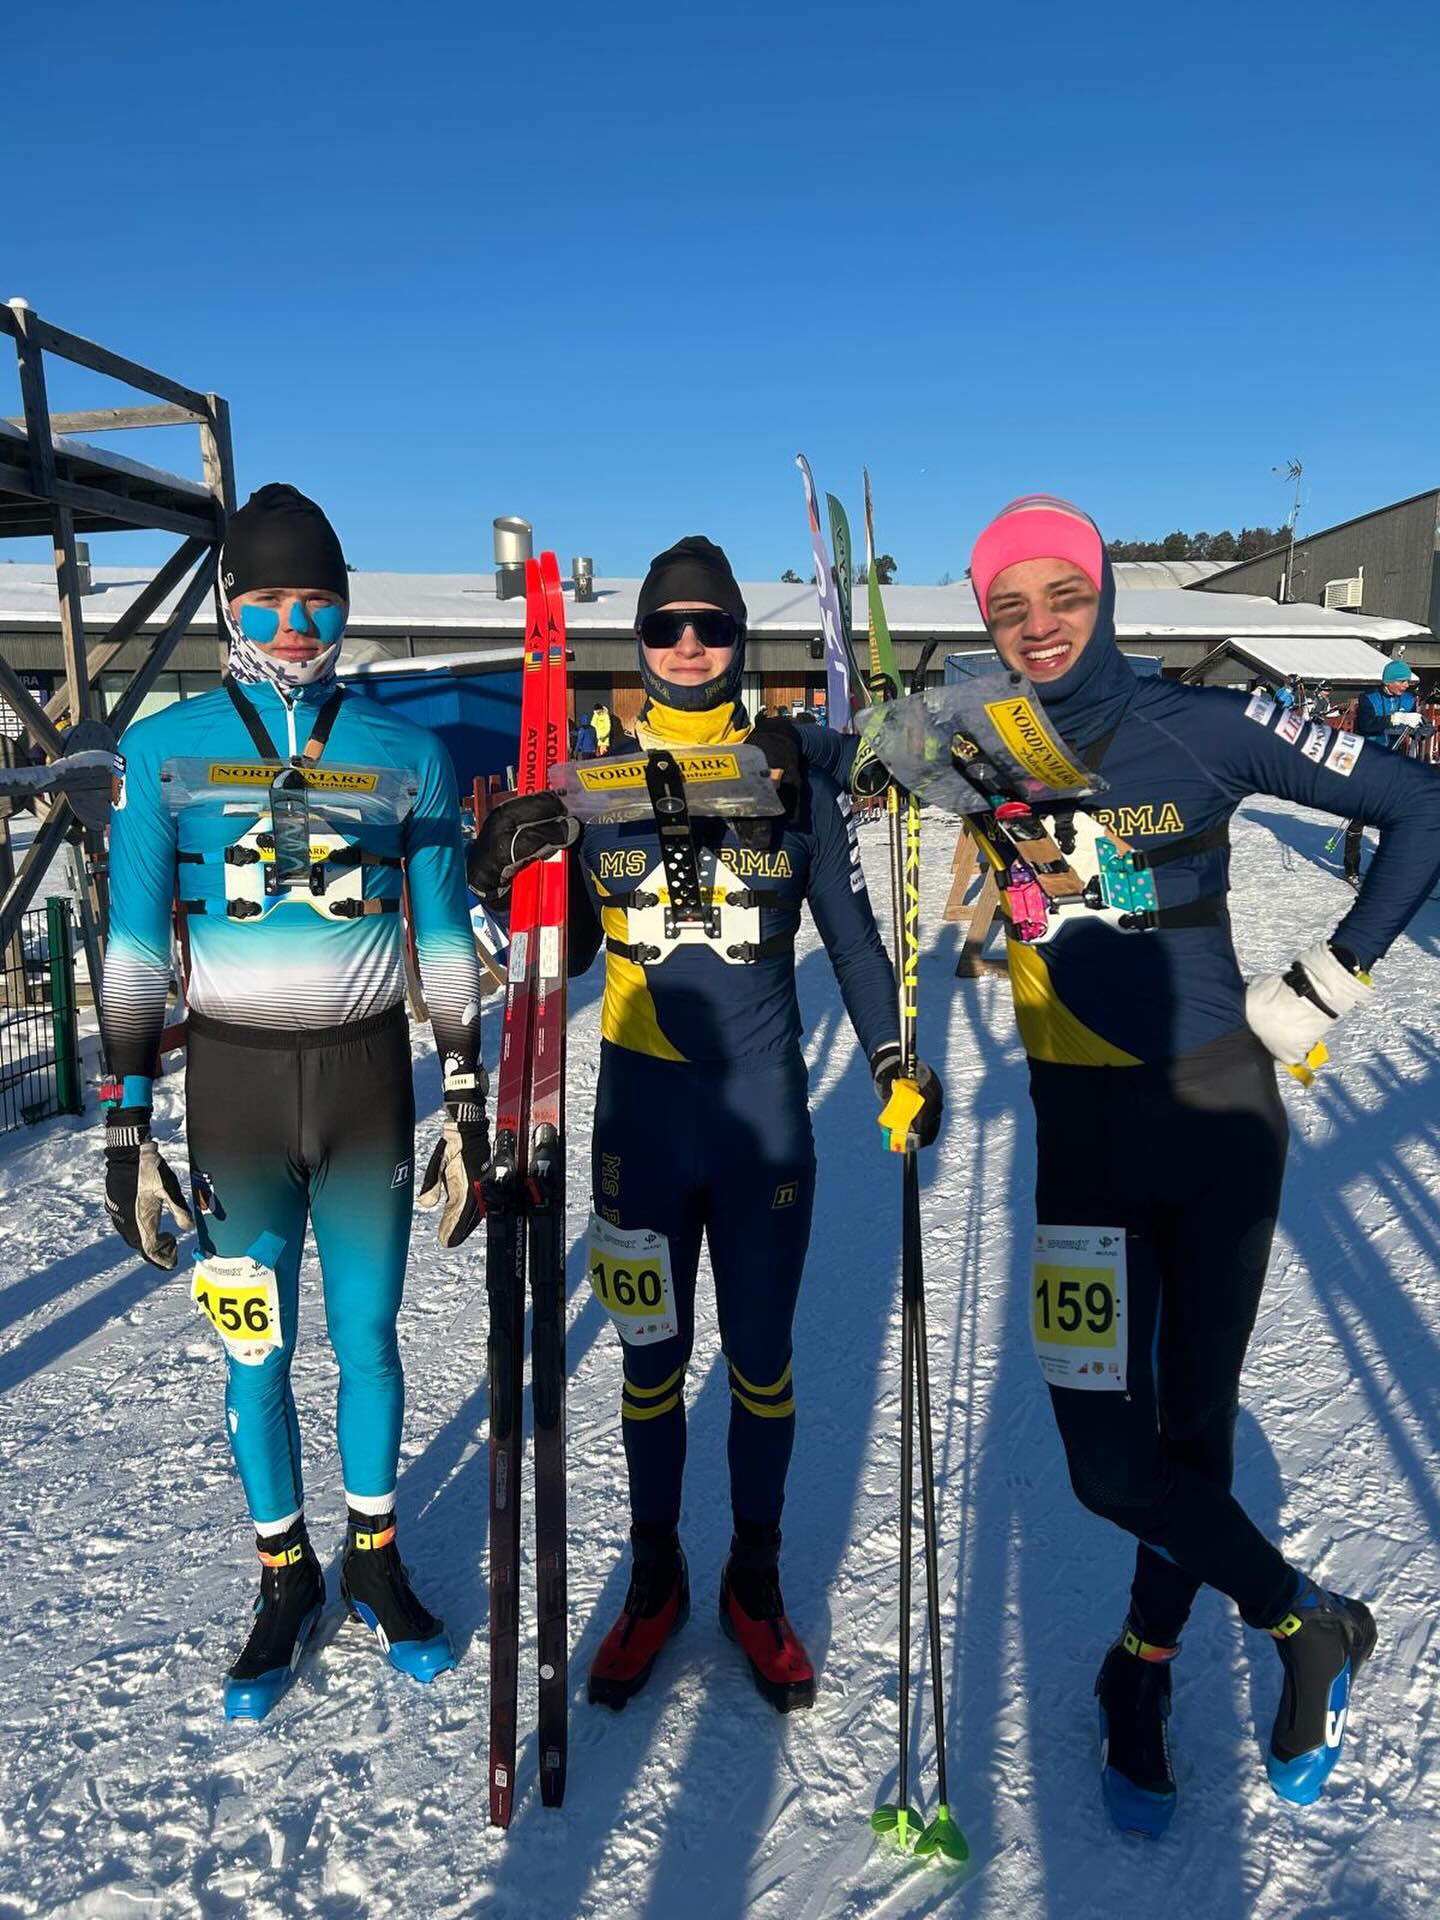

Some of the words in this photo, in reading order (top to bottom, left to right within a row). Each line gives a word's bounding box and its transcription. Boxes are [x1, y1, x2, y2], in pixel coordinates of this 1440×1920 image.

[217, 767, 370, 785] NORDMARK
[586, 758, 730, 783] NORDARK
[1093, 803, 1185, 837] RMA
[600, 850, 647, 878] MS
[720, 848, 793, 878] RMA
[602, 1152, 621, 1198] MS
[515, 1216, 524, 1279] ATOMIC
[591, 1262, 662, 1307] 160
[197, 1291, 269, 1332] 156
[1036, 1279, 1114, 1334] 159
